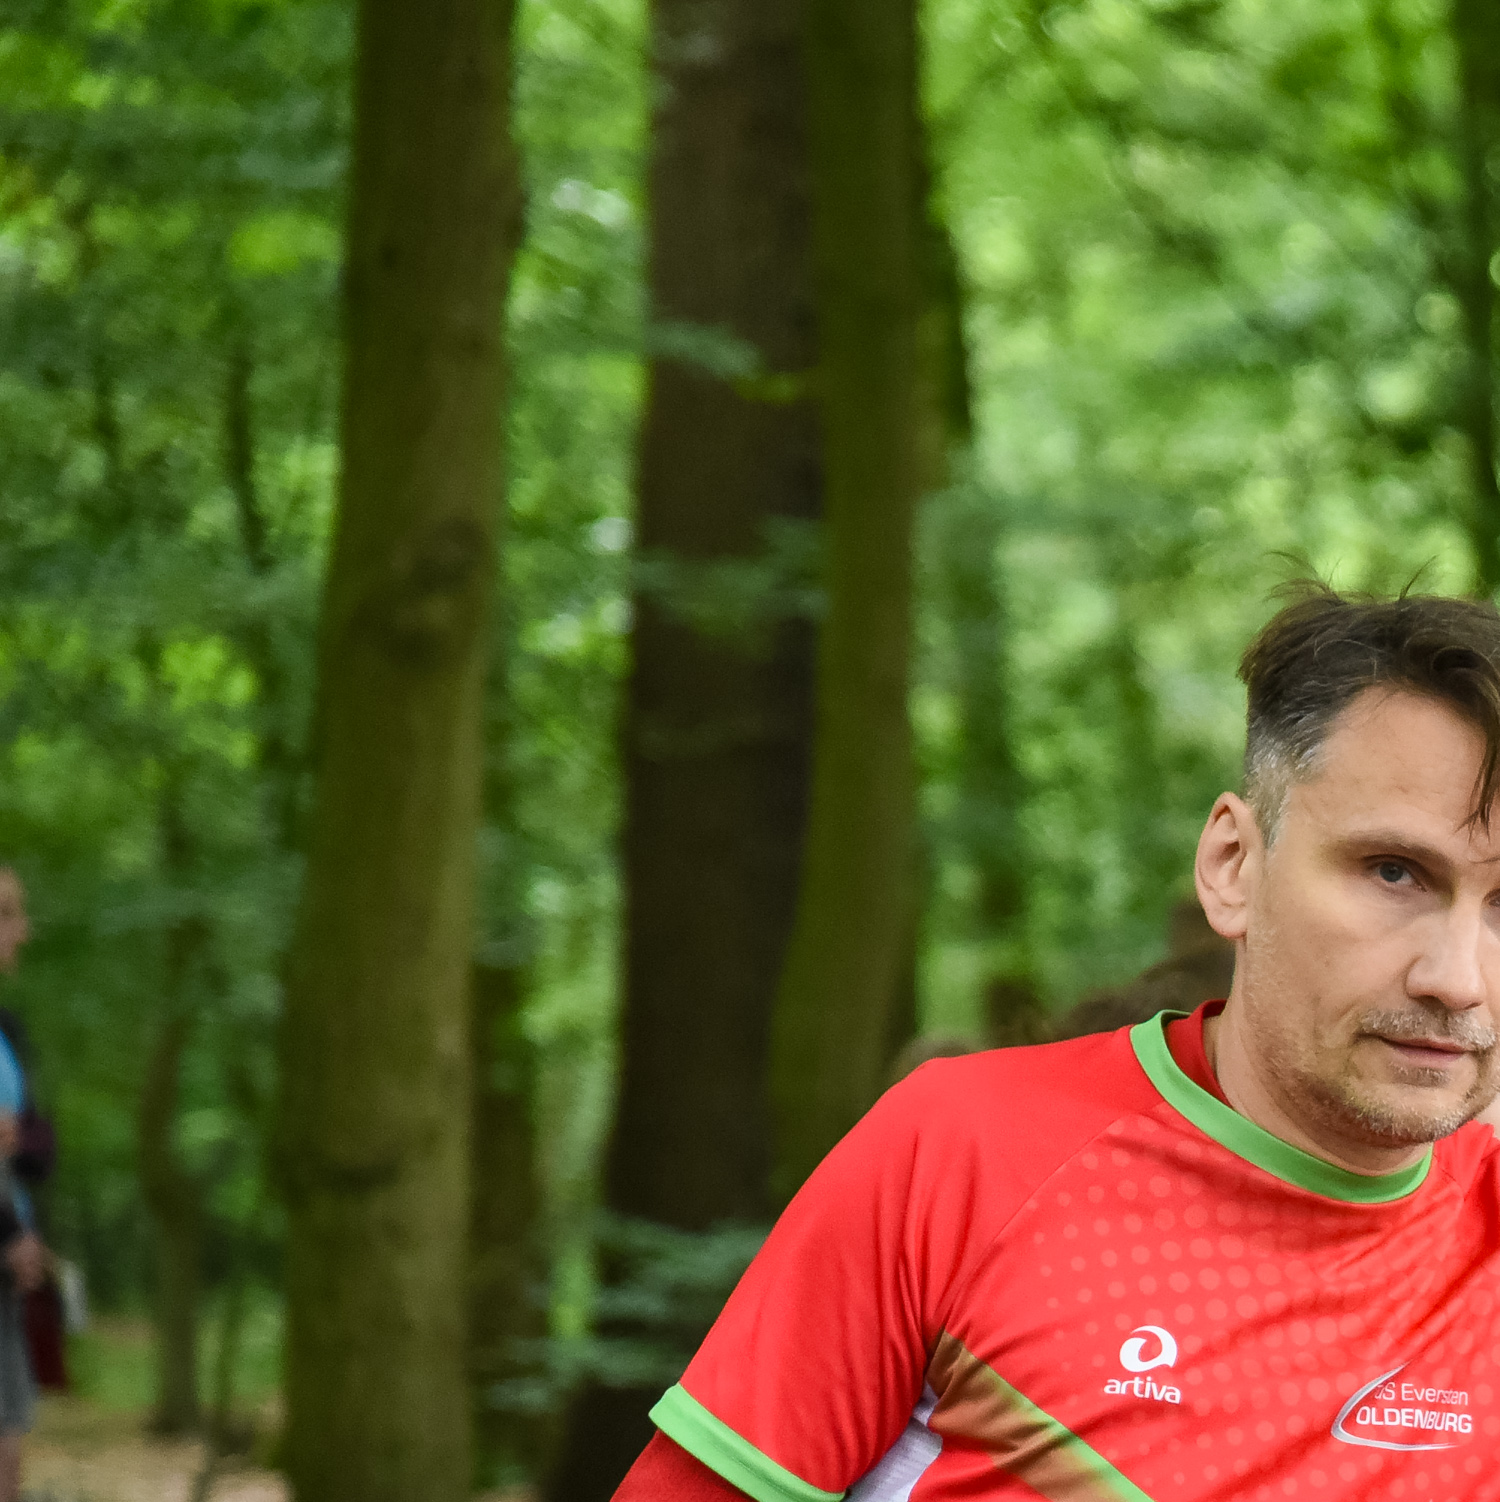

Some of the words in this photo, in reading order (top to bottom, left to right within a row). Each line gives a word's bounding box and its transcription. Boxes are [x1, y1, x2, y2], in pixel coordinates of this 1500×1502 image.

[1104, 1376, 1181, 1404] artiva
[1401, 1383, 1468, 1406] Eversten
[1356, 1405, 1473, 1434] OLDENBURG
